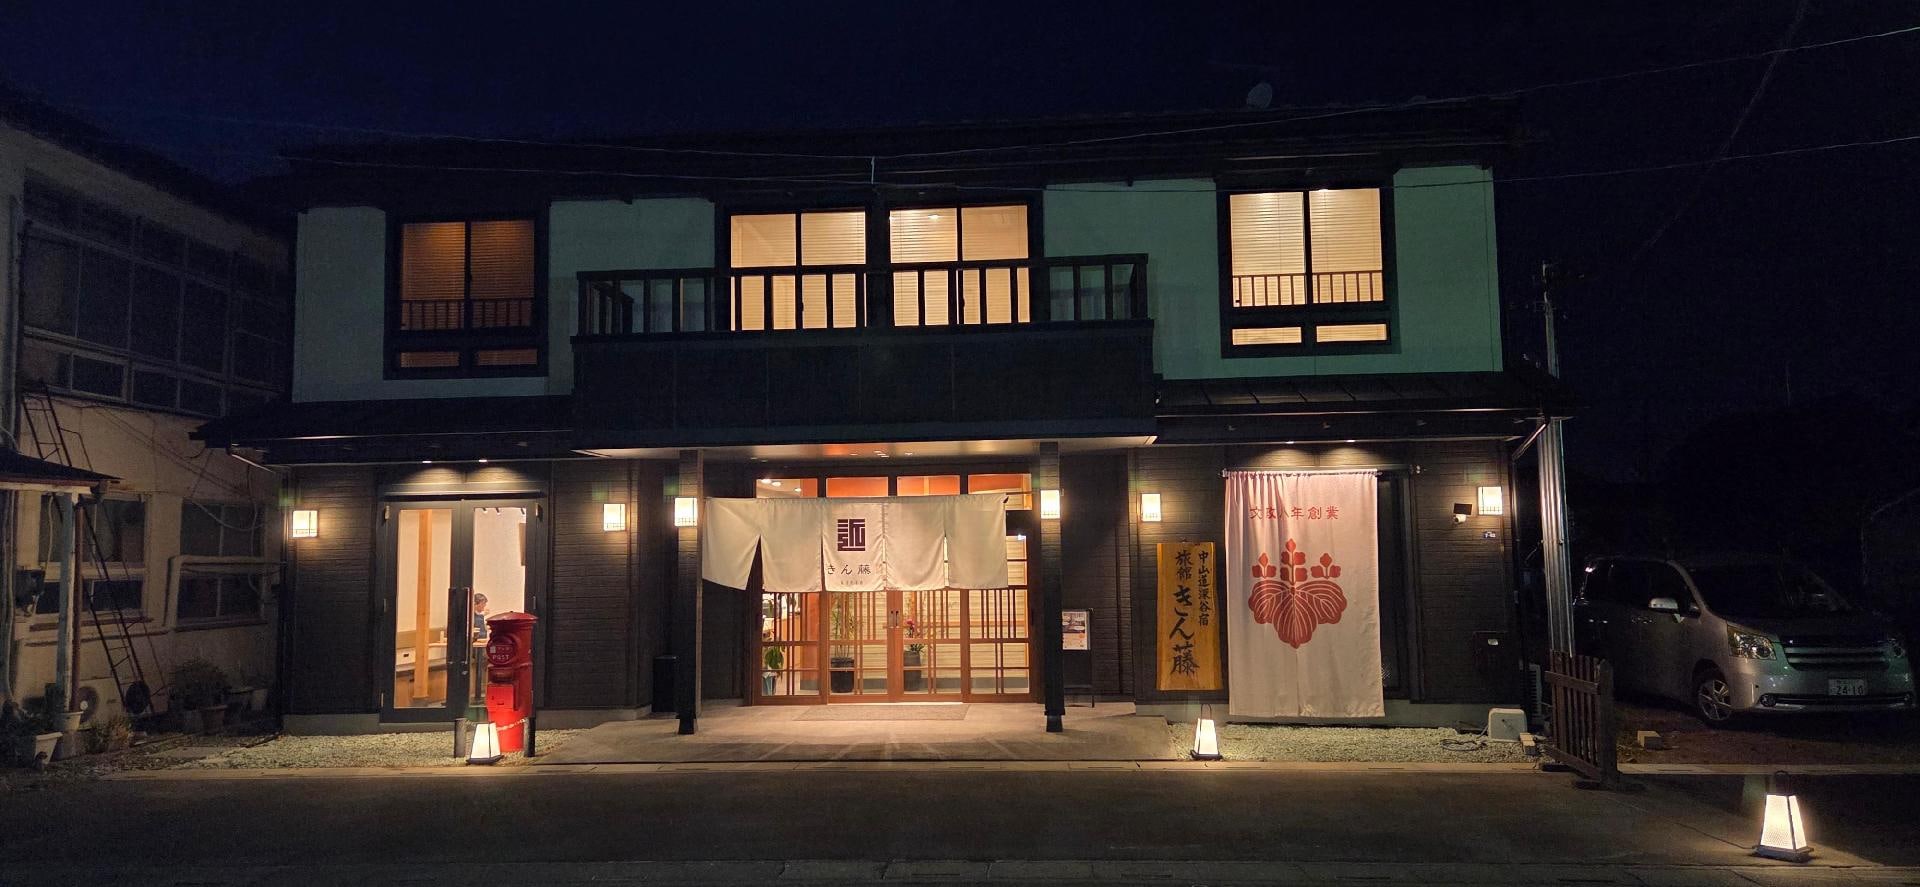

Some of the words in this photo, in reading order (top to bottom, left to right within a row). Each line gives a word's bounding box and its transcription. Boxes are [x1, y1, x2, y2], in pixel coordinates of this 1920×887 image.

[827, 564, 872, 575] きん藤
[1198, 550, 1211, 626] 中山道深谷宿
